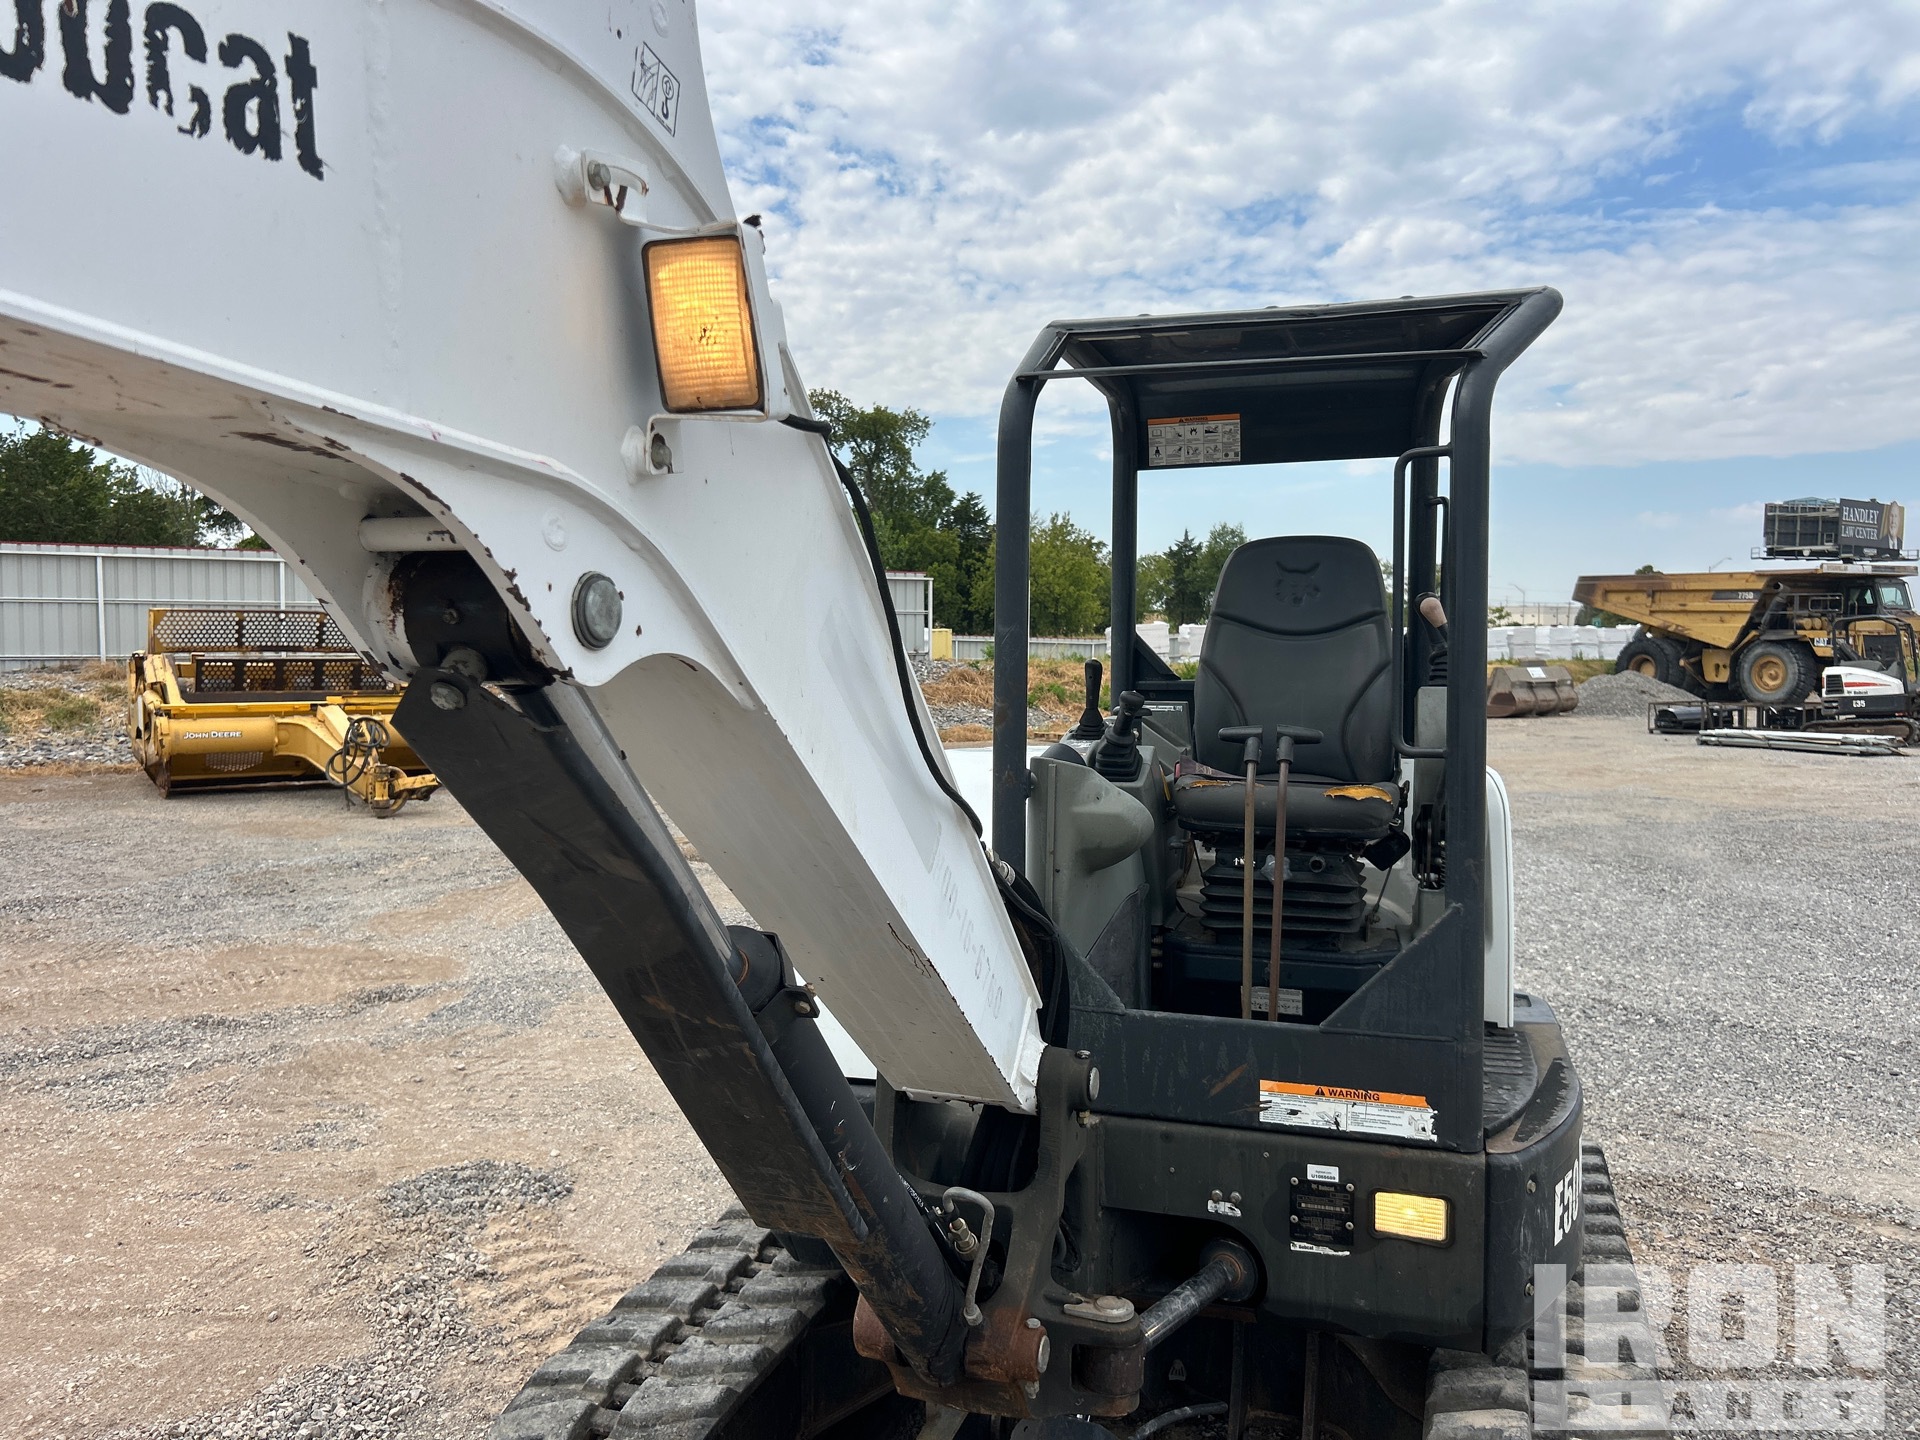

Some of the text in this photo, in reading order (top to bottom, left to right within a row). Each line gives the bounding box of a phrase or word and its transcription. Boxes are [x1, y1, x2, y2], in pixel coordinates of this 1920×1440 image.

[1842, 506, 1879, 524] HANDLEY
[1841, 525, 1878, 540] LAW CENTER
[183, 730, 242, 740] JOHN DEERE
[1328, 1088, 1380, 1101] WARNING
